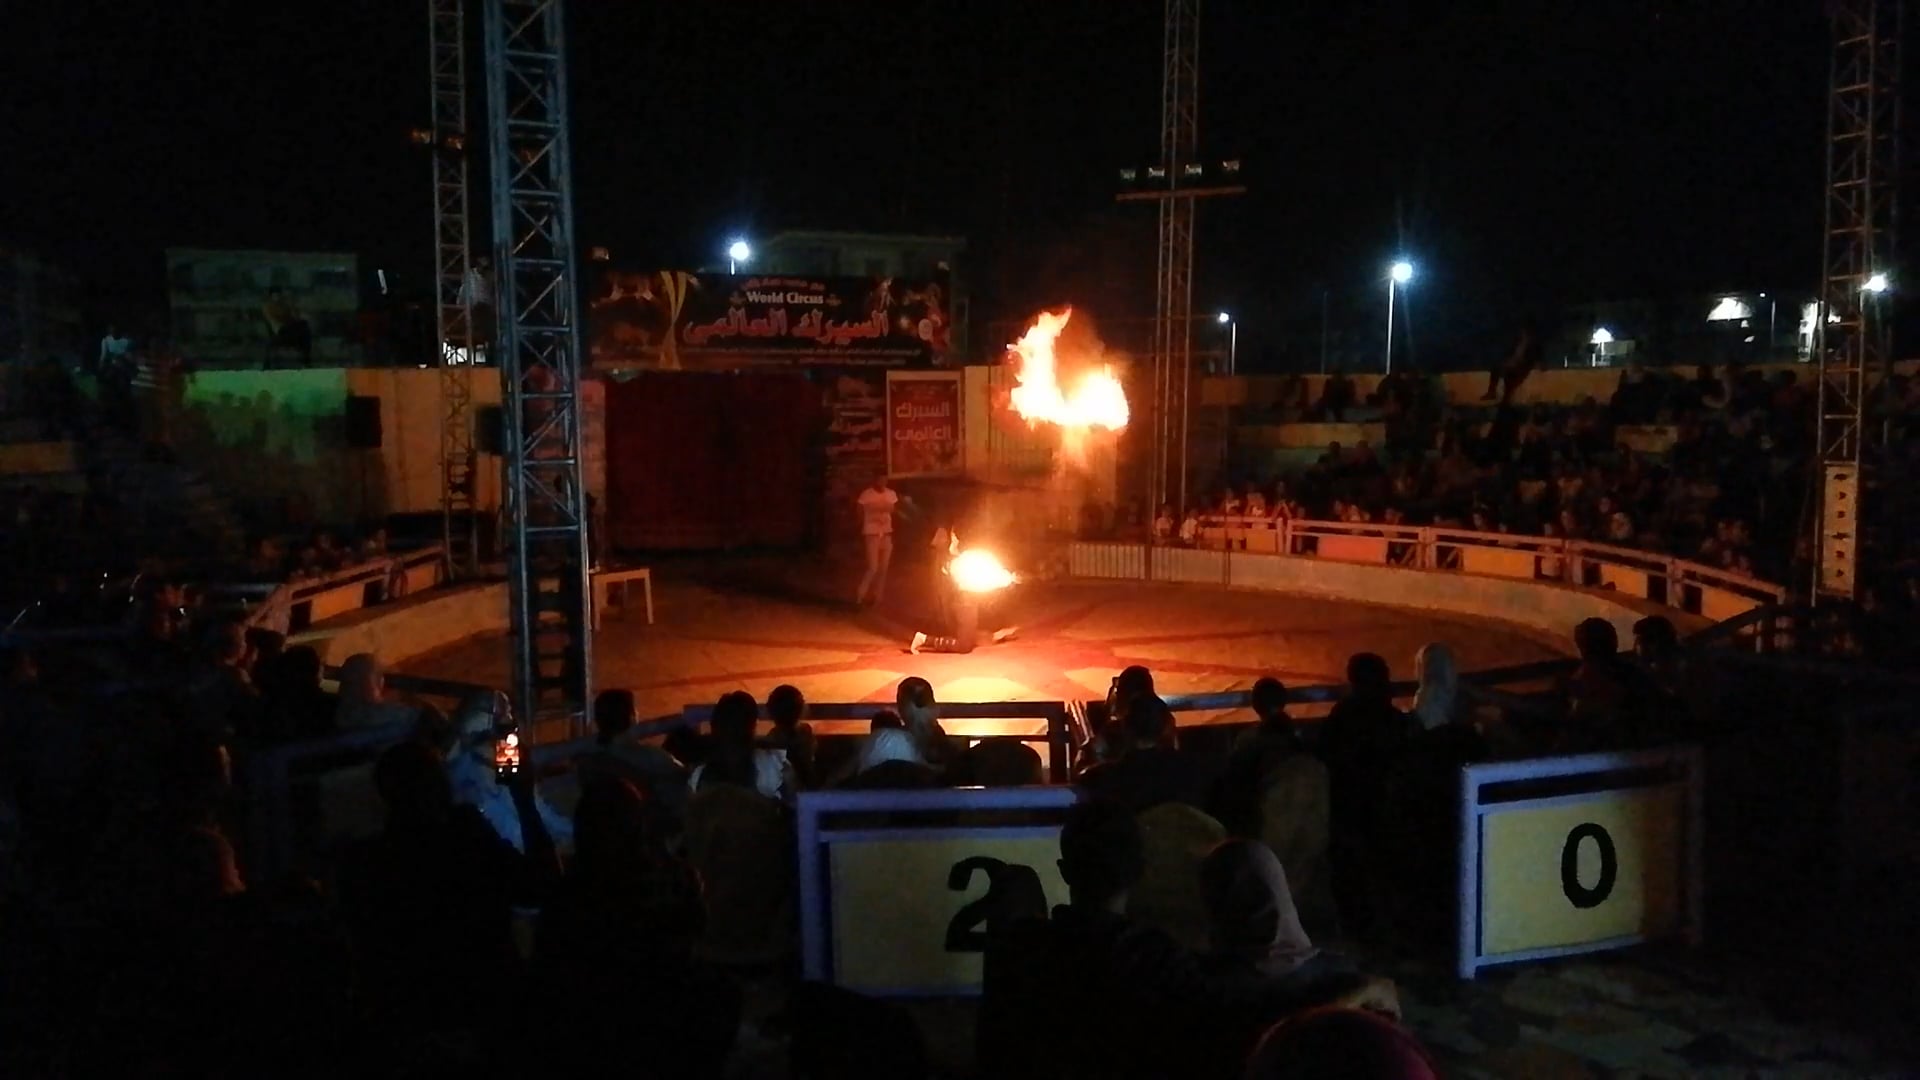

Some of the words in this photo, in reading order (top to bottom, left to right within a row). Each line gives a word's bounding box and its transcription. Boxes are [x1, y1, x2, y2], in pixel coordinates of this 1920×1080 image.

[746, 291, 784, 304] World
[786, 291, 824, 304] Circus
[791, 308, 888, 345] السيرك
